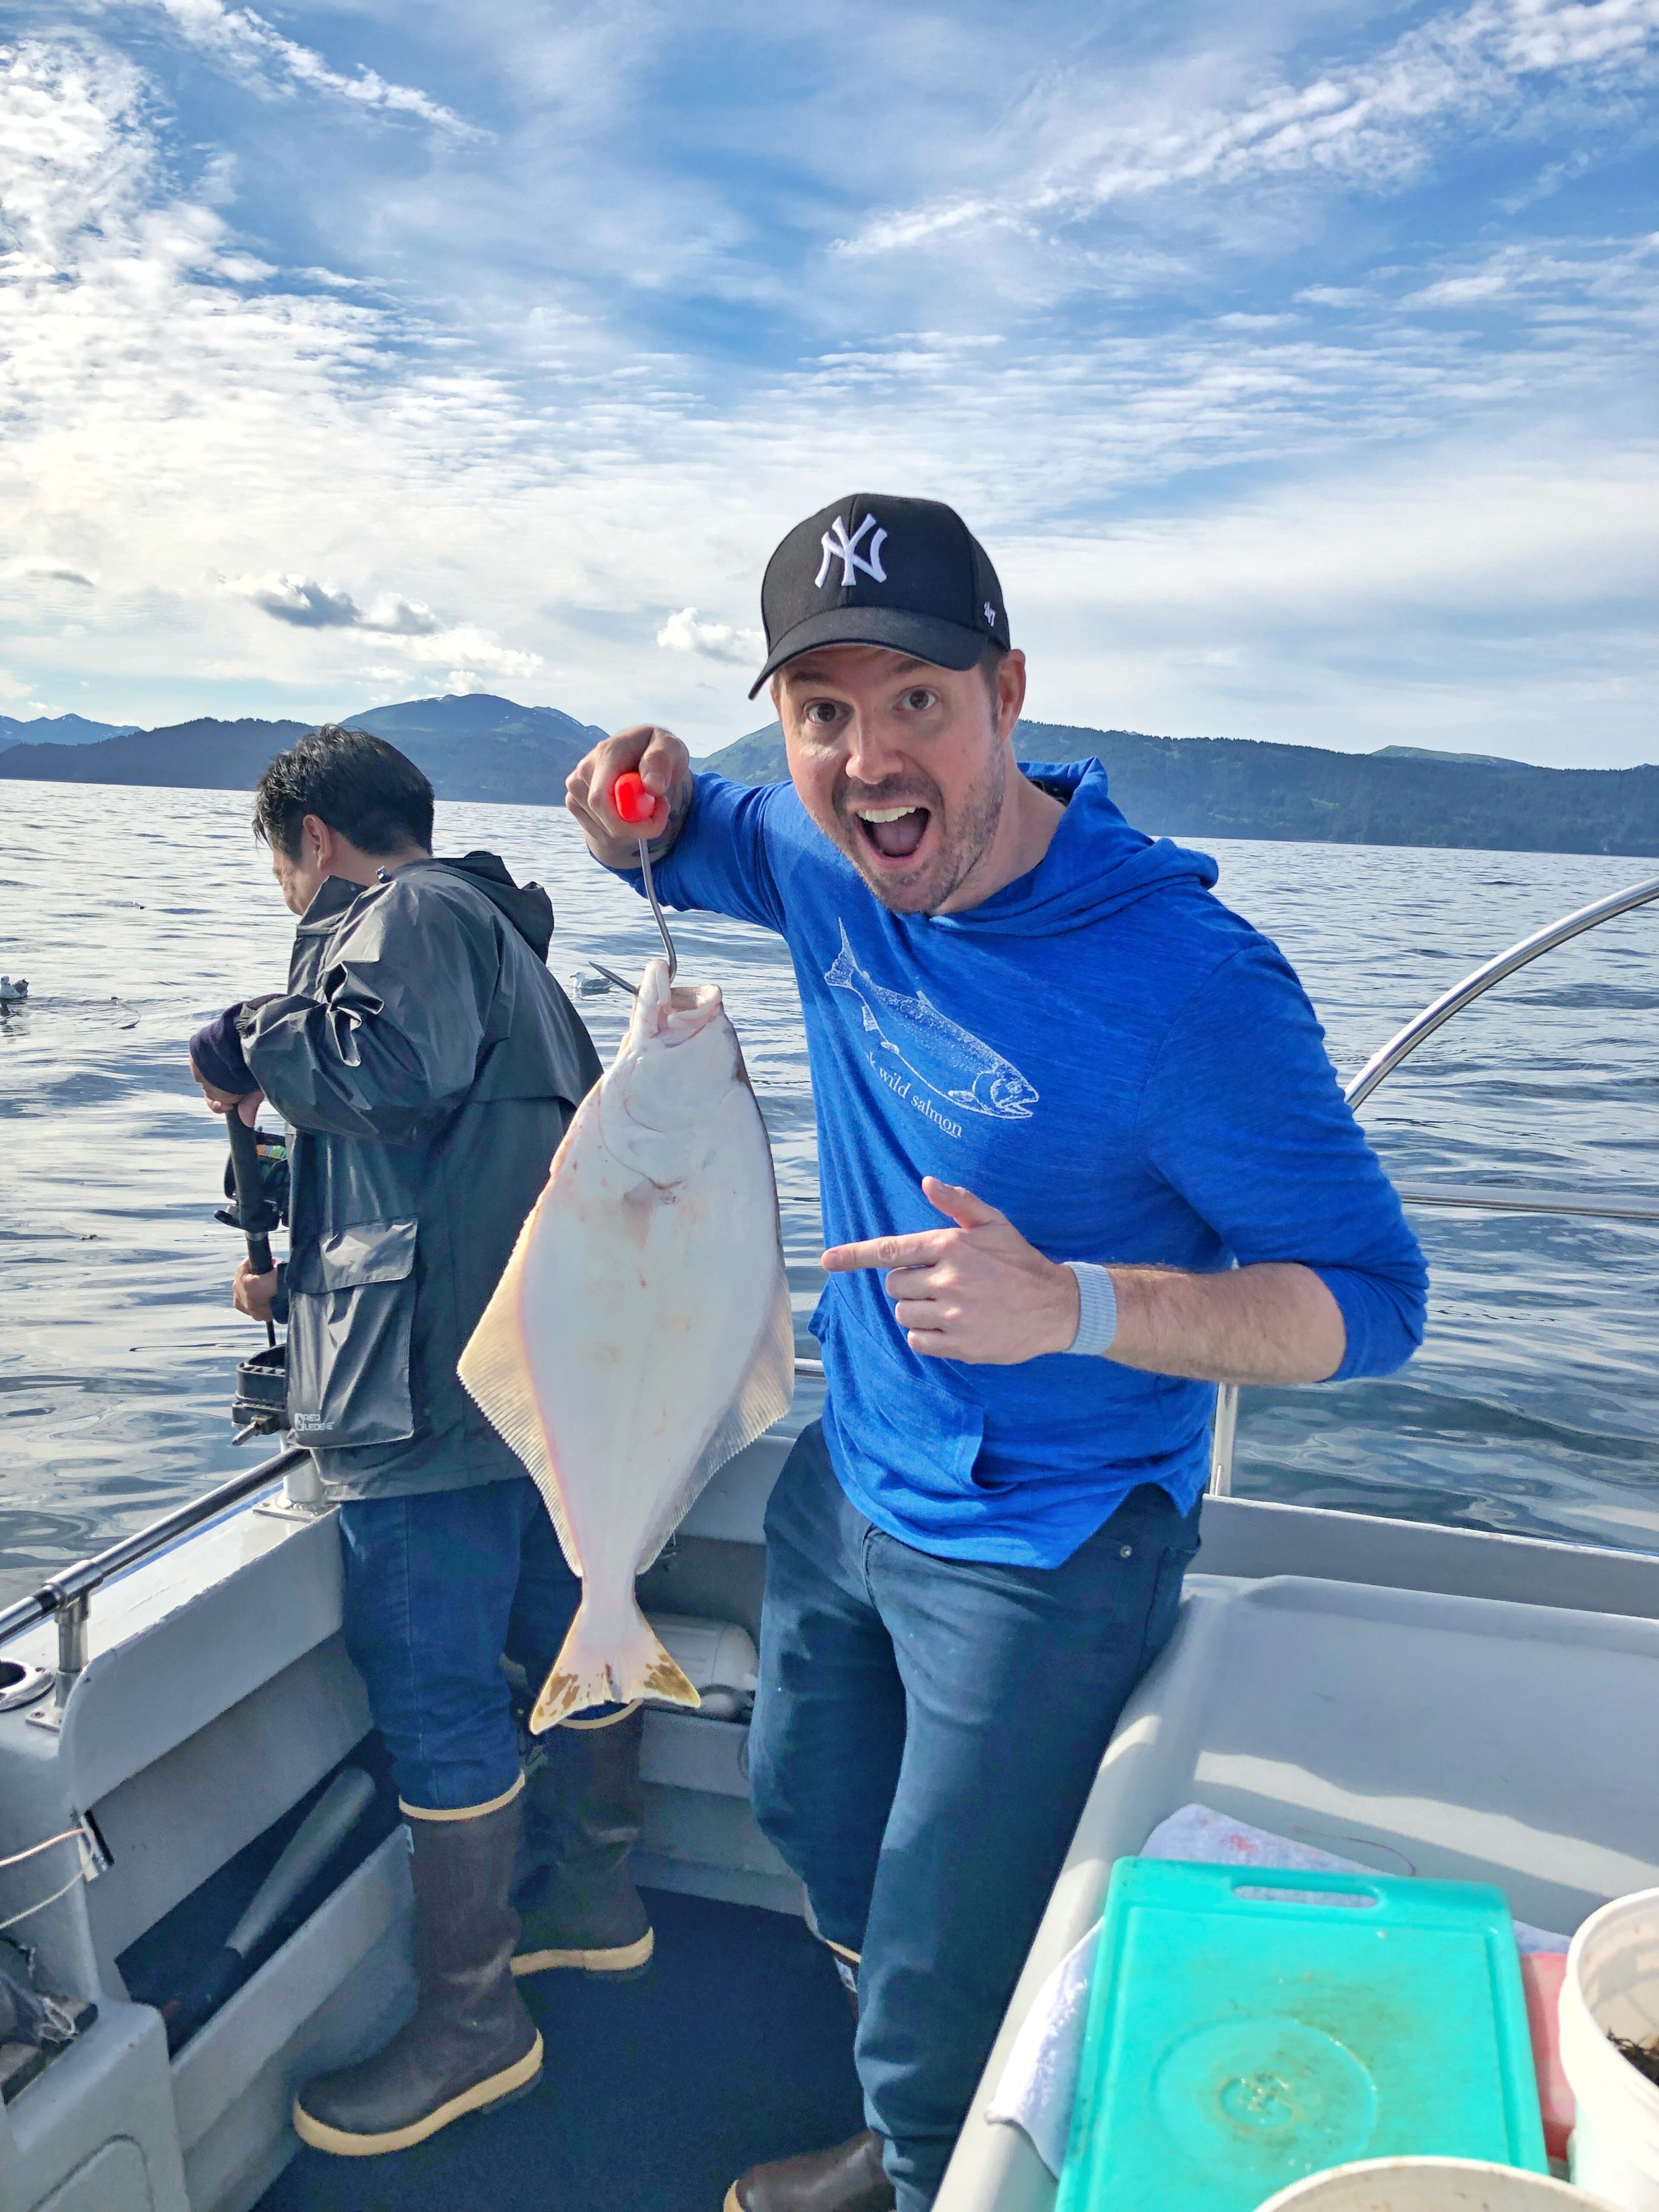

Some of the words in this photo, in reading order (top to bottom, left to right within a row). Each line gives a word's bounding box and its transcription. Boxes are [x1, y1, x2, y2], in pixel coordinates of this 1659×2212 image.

[815, 513, 888, 588] NY
[879, 1068, 911, 1099] wild
[911, 1095, 962, 1137] salmon
